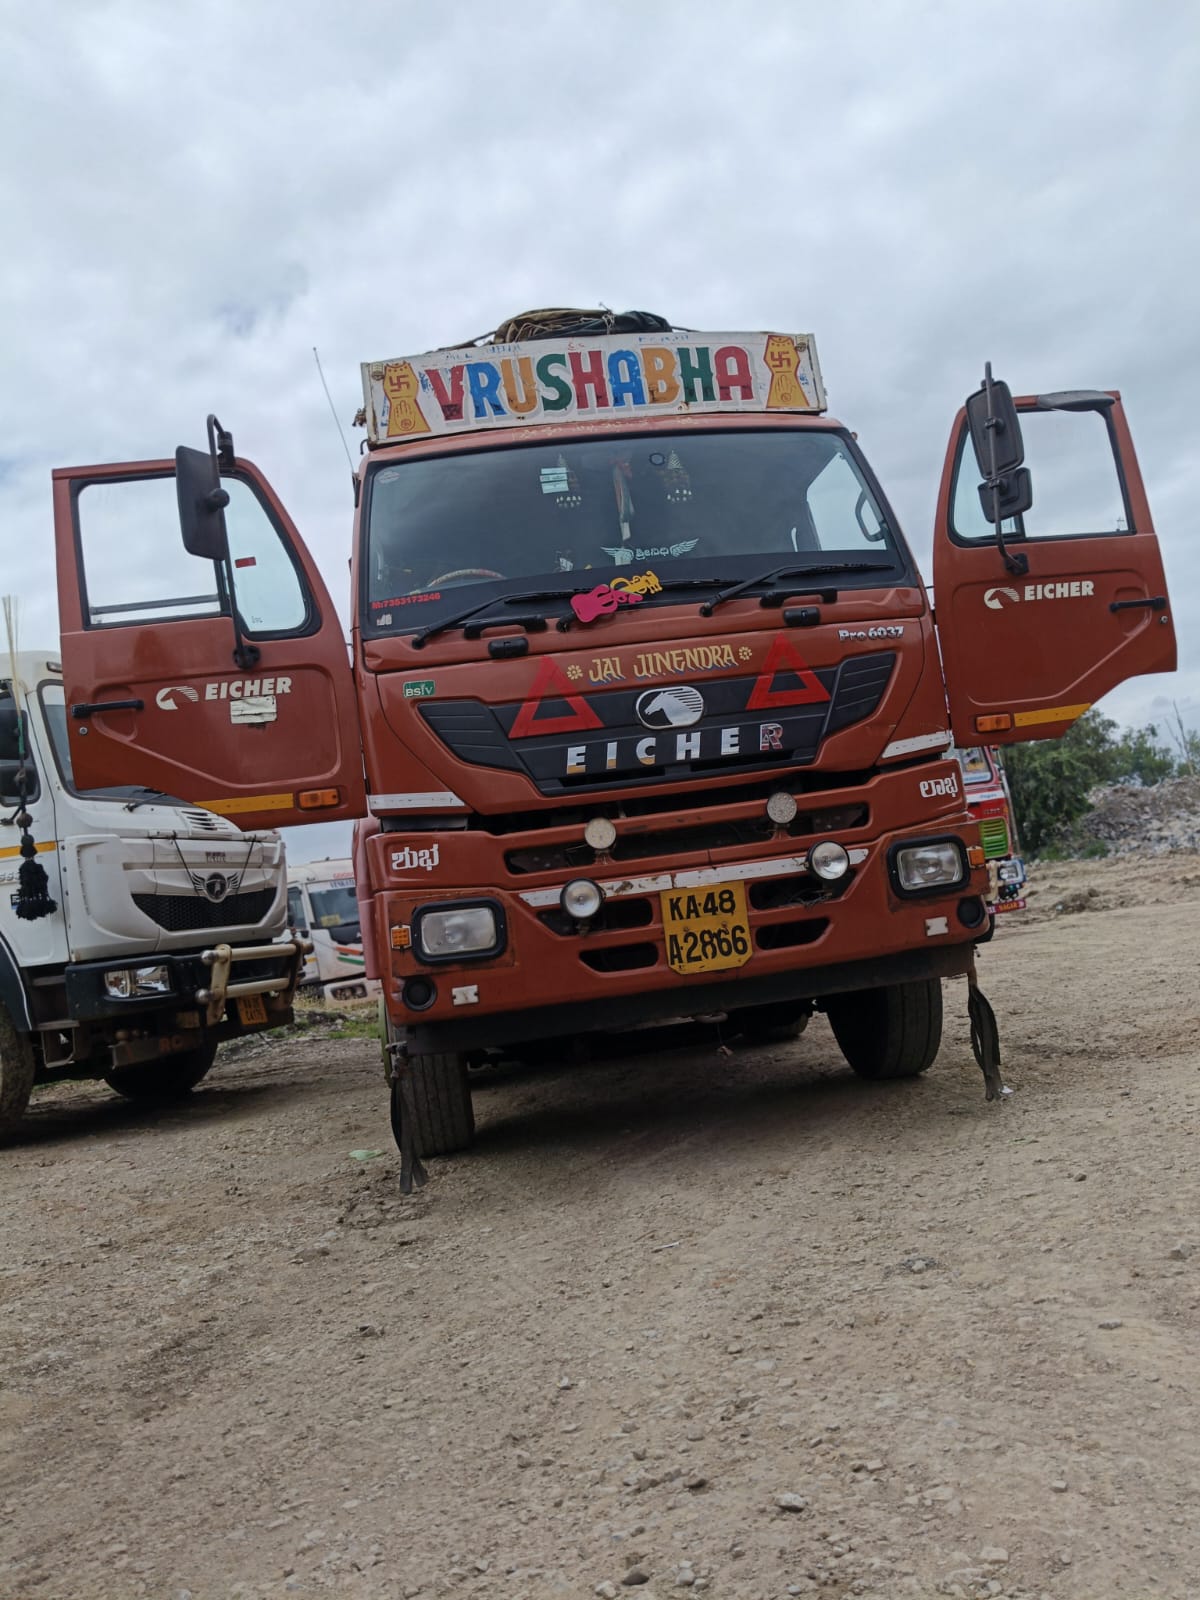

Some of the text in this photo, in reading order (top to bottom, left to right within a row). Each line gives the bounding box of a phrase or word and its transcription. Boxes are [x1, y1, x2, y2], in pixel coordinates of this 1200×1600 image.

[424, 345, 754, 421] VRUSHABHA
[1024, 580, 1095, 601] EICHER
[838, 626, 904, 641] Pro 6037
[588, 644, 739, 684] JAI JINENDRA
[205, 677, 292, 701] EICHER
[566, 722, 784, 776] EICHER
[919, 772, 959, 798] ಲಾಭ
[391, 843, 440, 872] ಶುಭ
